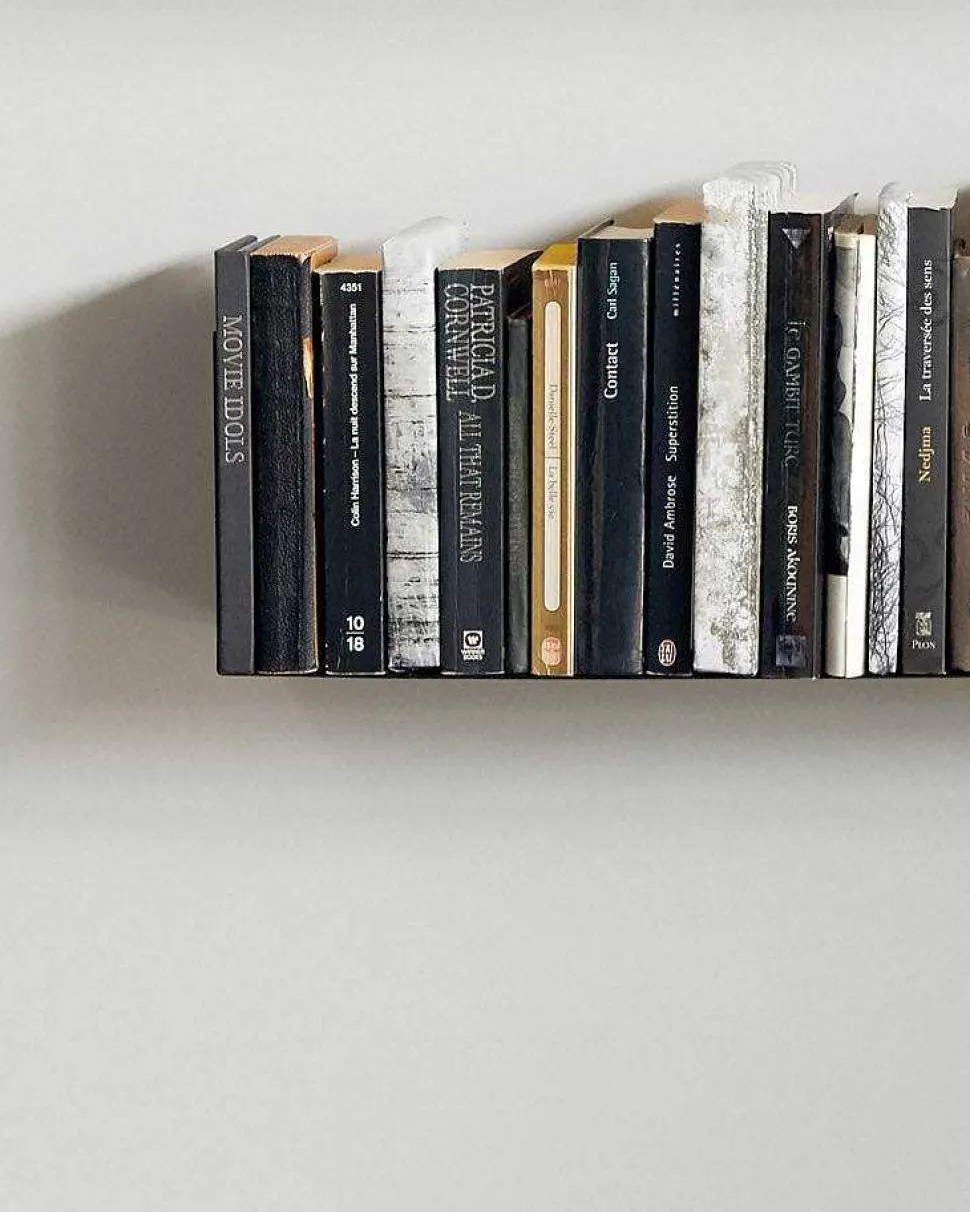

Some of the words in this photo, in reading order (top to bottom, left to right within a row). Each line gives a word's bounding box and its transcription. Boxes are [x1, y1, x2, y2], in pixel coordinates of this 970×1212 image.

[340, 282, 363, 293] 4351
[606, 261, 620, 296] Sagan
[922, 259, 932, 289] sens
[606, 298, 618, 320] Carl
[919, 292, 933, 316] des
[348, 303, 358, 354] Manhattan
[445, 282, 470, 402] CORNWELL
[469, 282, 495, 381] PATRICIA
[222, 315, 243, 390] MOVIE
[350, 356, 358, 372] sur
[920, 318, 933, 380] traversée
[604, 342, 619, 400] Contact
[349, 374, 359, 415] descend
[469, 384, 495, 404] D.
[919, 384, 931, 401] La
[224, 396, 244, 464] IDOLS
[350, 417, 359, 435] nuit
[458, 410, 482, 441] ALL
[665, 385, 680, 462] Superstition
[350, 436, 359, 450] La
[918, 426, 935, 483] Nedjma
[350, 459, 360, 500] Harrison
[459, 443, 482, 488] THAT
[350, 501, 360, 527] Colin
[663, 475, 677, 530] Ambrose
[459, 491, 483, 563] REMAINS
[662, 533, 675, 569] David
[346, 615, 365, 632] 10
[346, 635, 365, 652] 18
